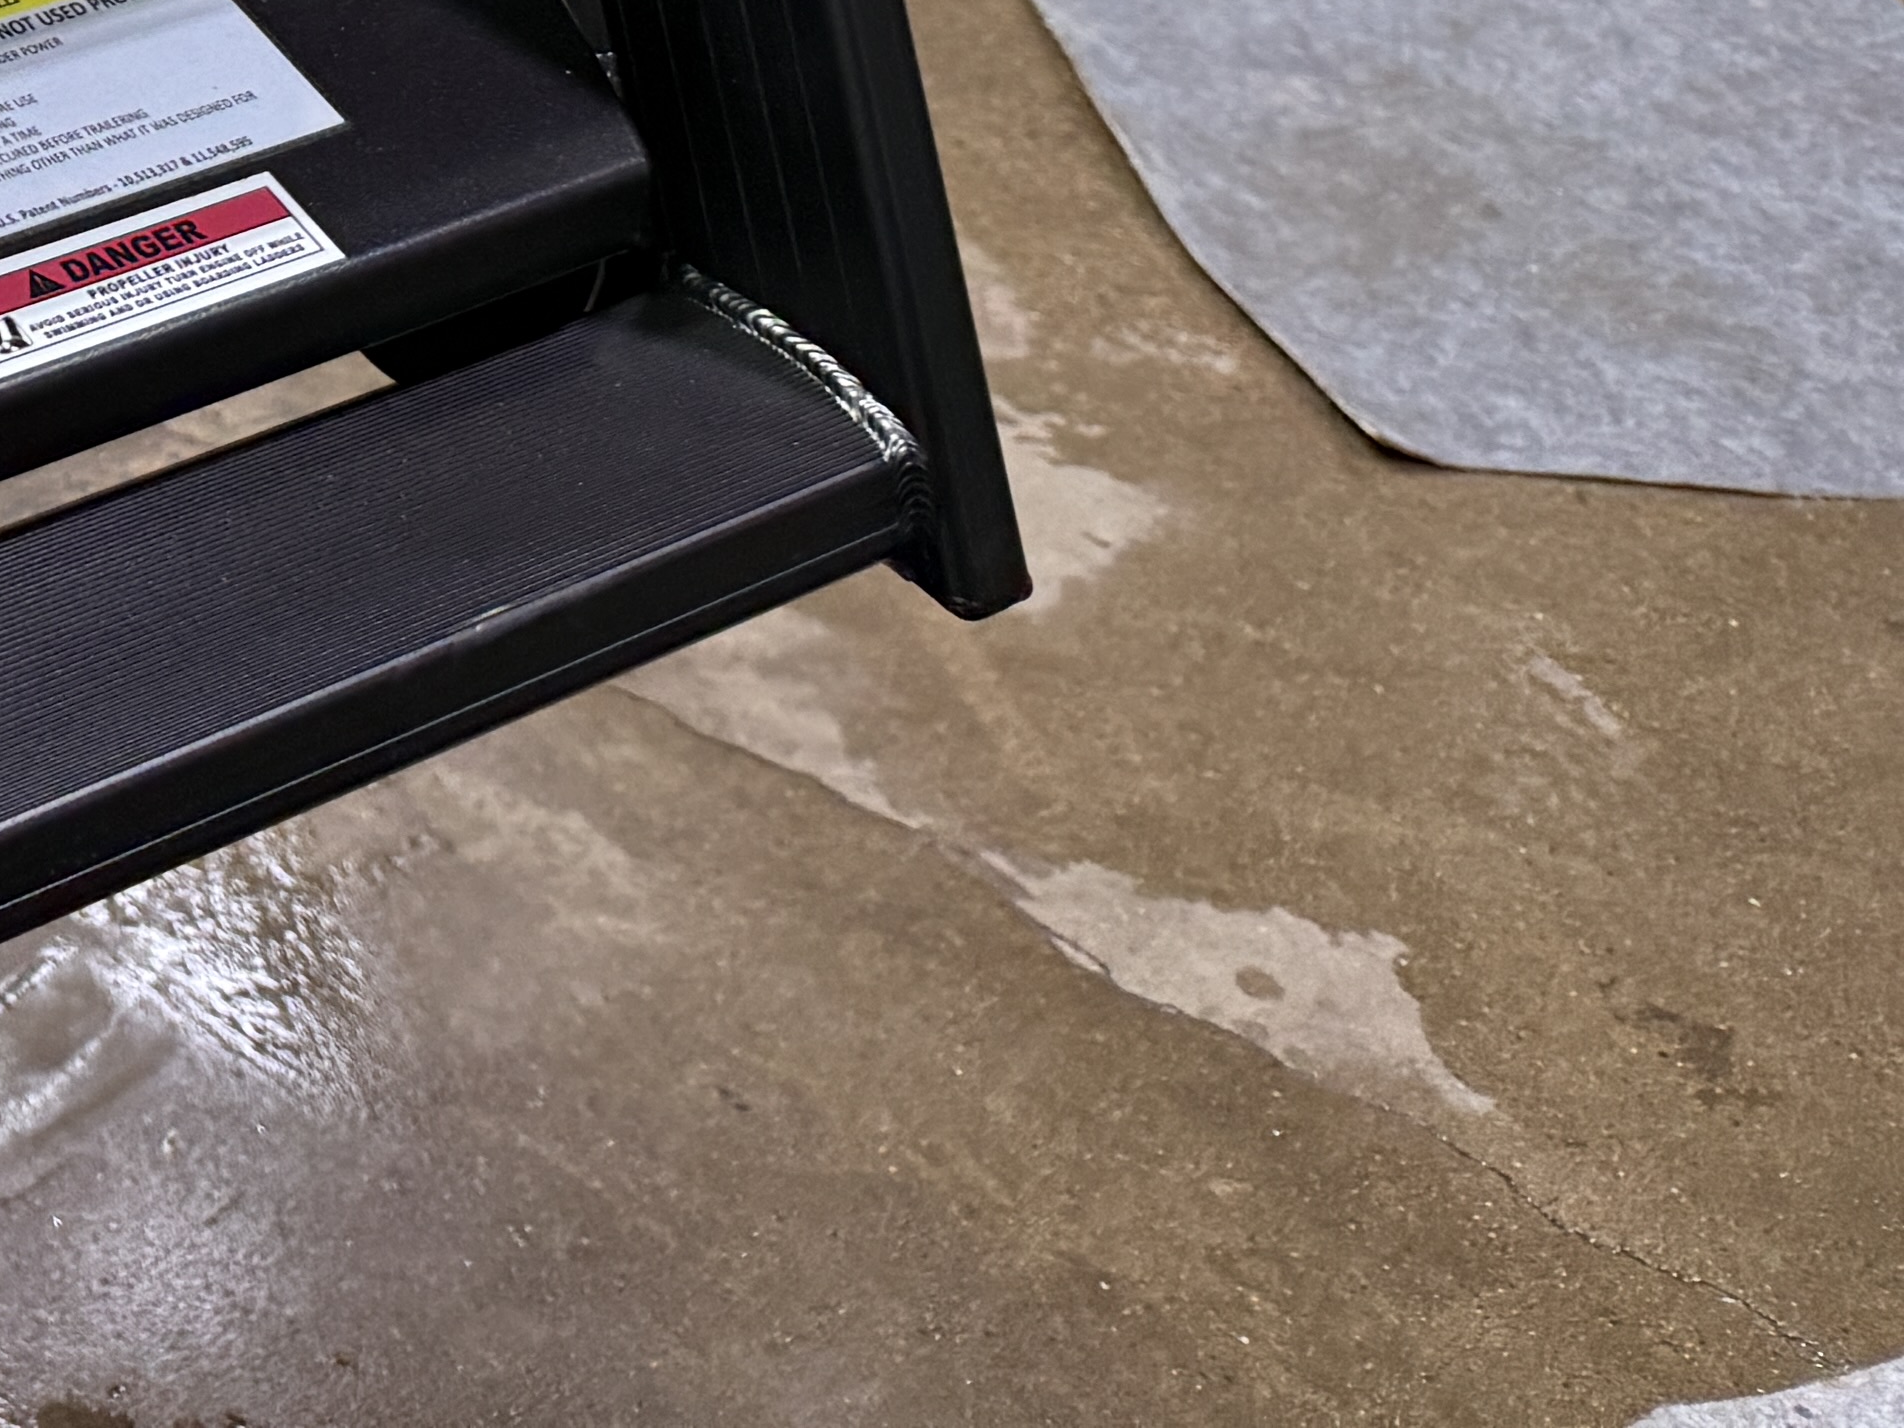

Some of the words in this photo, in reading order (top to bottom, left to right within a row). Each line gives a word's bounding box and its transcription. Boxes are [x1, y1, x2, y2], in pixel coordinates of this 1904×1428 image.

[34, 1, 88, 26] USED
[19, 36, 64, 56] POWER
[11, 92, 39, 108] USE
[8, 124, 43, 142] TIME
[30, 150, 72, 171] OTHER
[68, 139, 105, 157] THAN
[102, 127, 138, 147] WHAT
[136, 123, 151, 136] IT
[148, 115, 179, 131] WAS
[230, 89, 258, 105] FOR
[37, 128, 84, 151] BEFORE
[59, 219, 206, 282] DANGER
[86, 262, 175, 299] PROPELLER
[174, 243, 230, 269] INJURY
